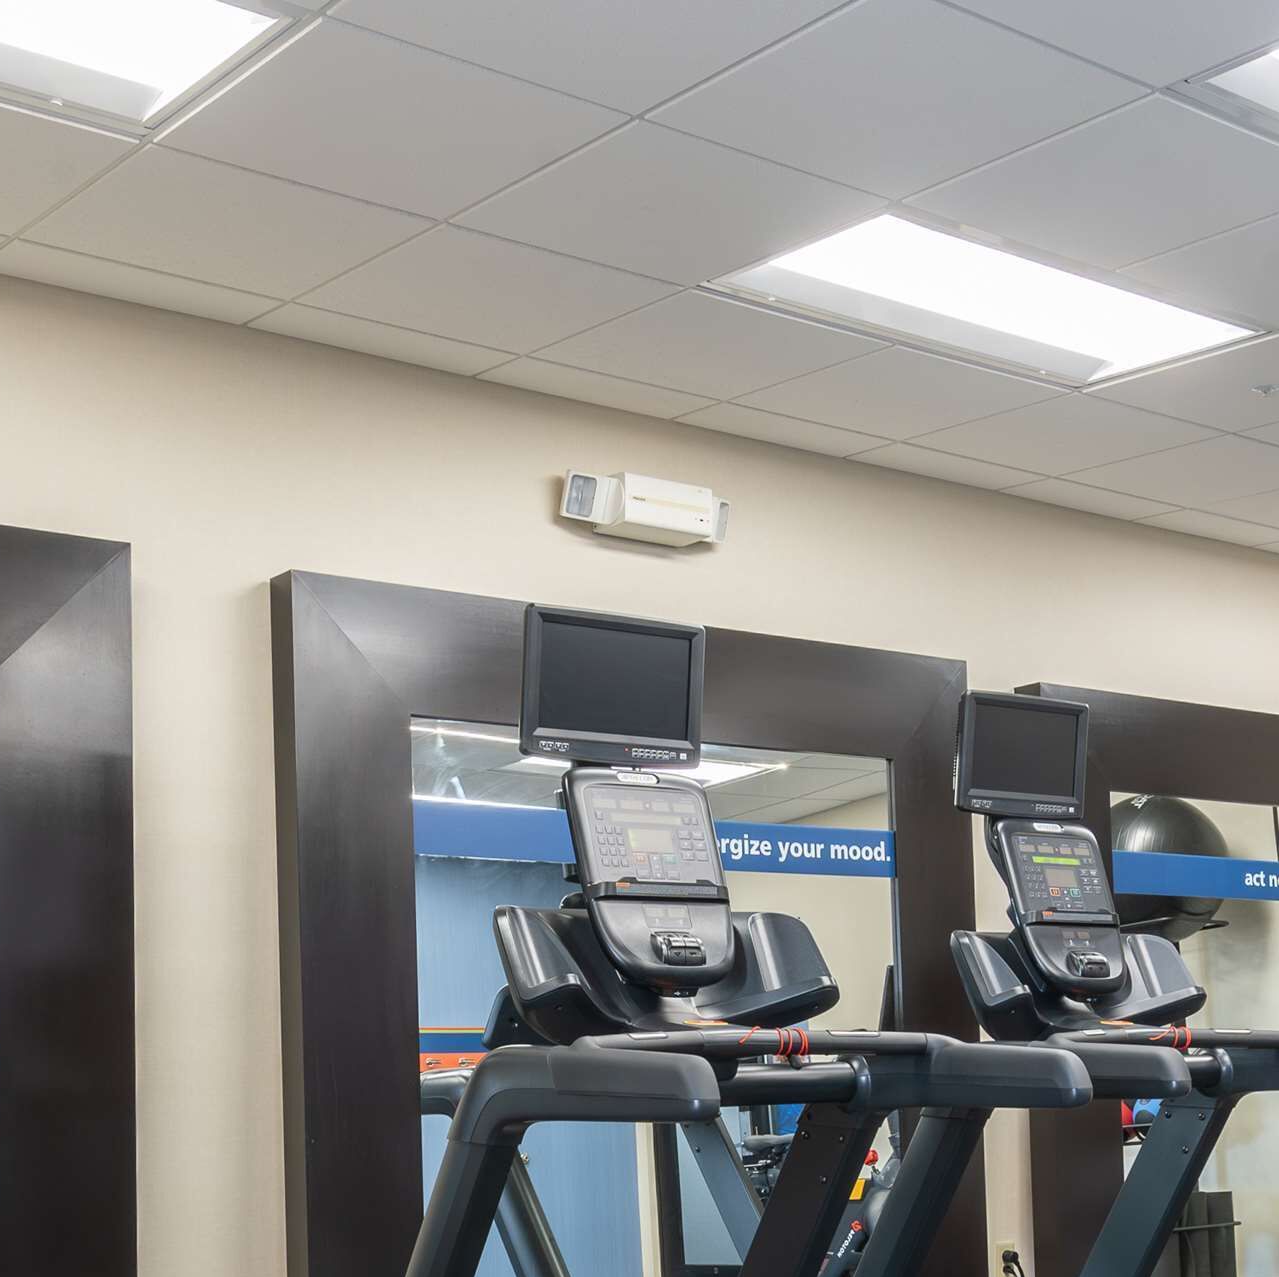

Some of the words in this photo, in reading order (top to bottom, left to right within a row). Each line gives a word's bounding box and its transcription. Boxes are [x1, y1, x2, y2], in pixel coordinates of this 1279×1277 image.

[717, 834, 773, 860] rgize
[778, 841, 824, 863] your
[830, 841, 891, 862] mood.
[1244, 871, 1266, 887] act
